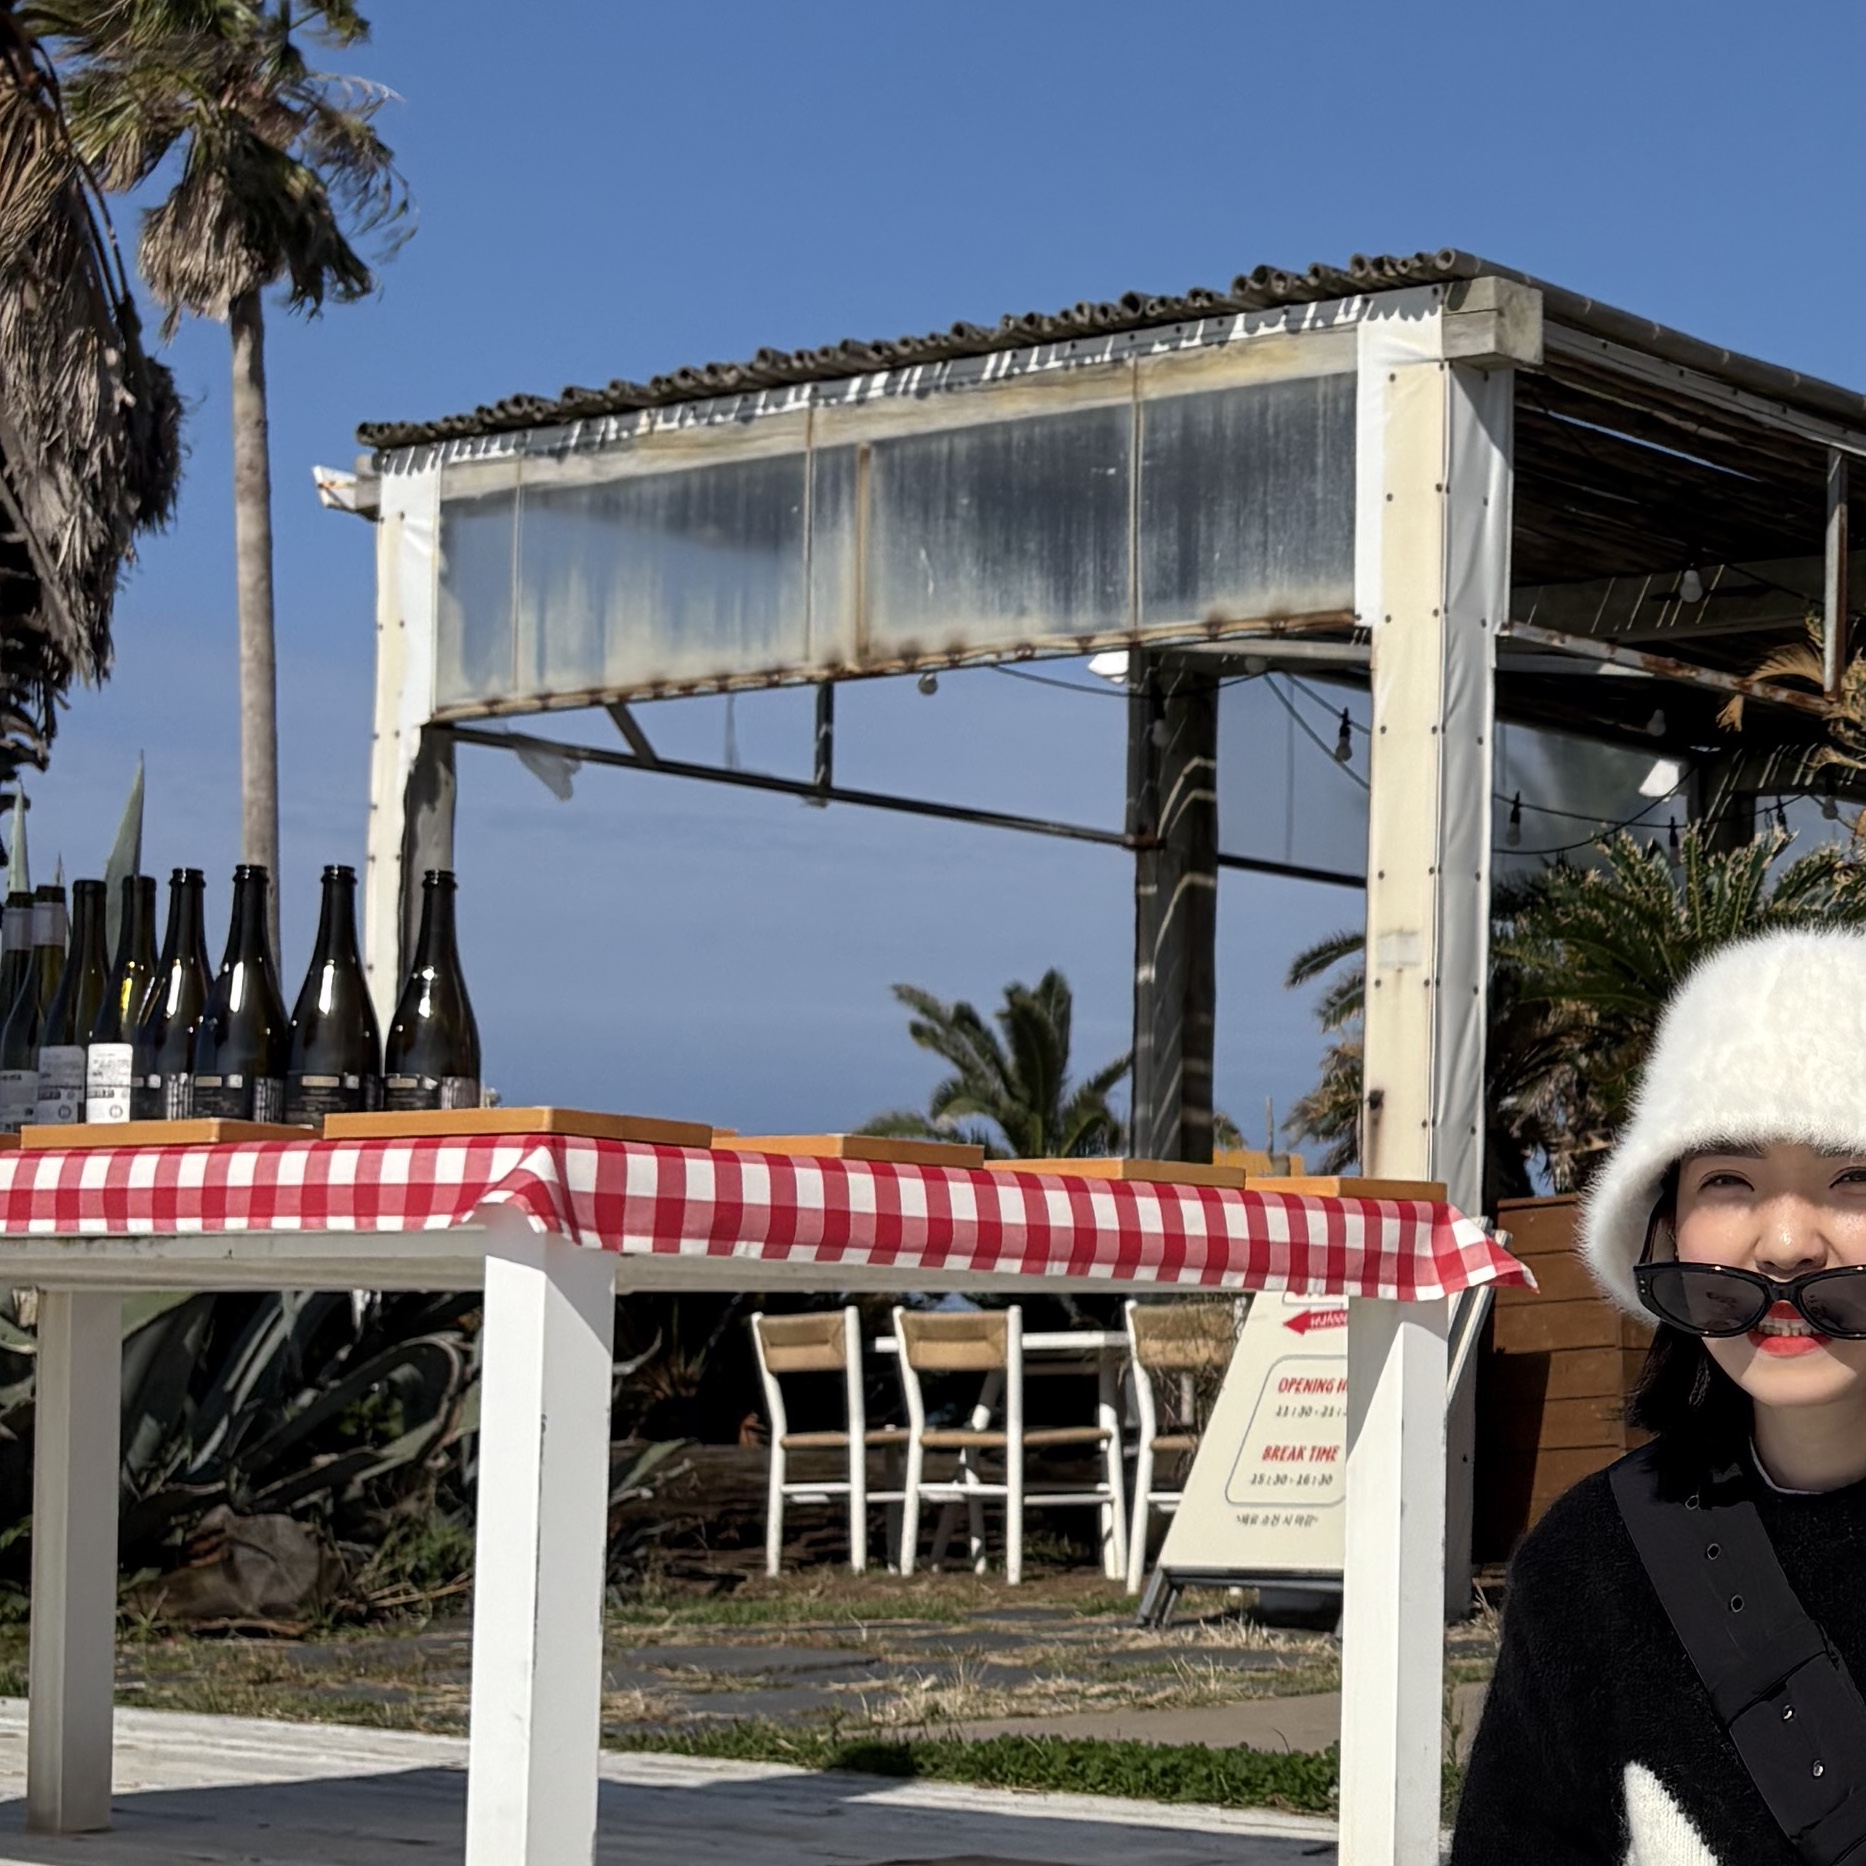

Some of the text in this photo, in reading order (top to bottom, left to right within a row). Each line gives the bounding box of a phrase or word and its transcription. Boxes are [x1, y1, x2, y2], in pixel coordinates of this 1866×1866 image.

[1278, 1377, 1334, 1394] OPENING
[1262, 1444, 1340, 1462] BREAK TIME
